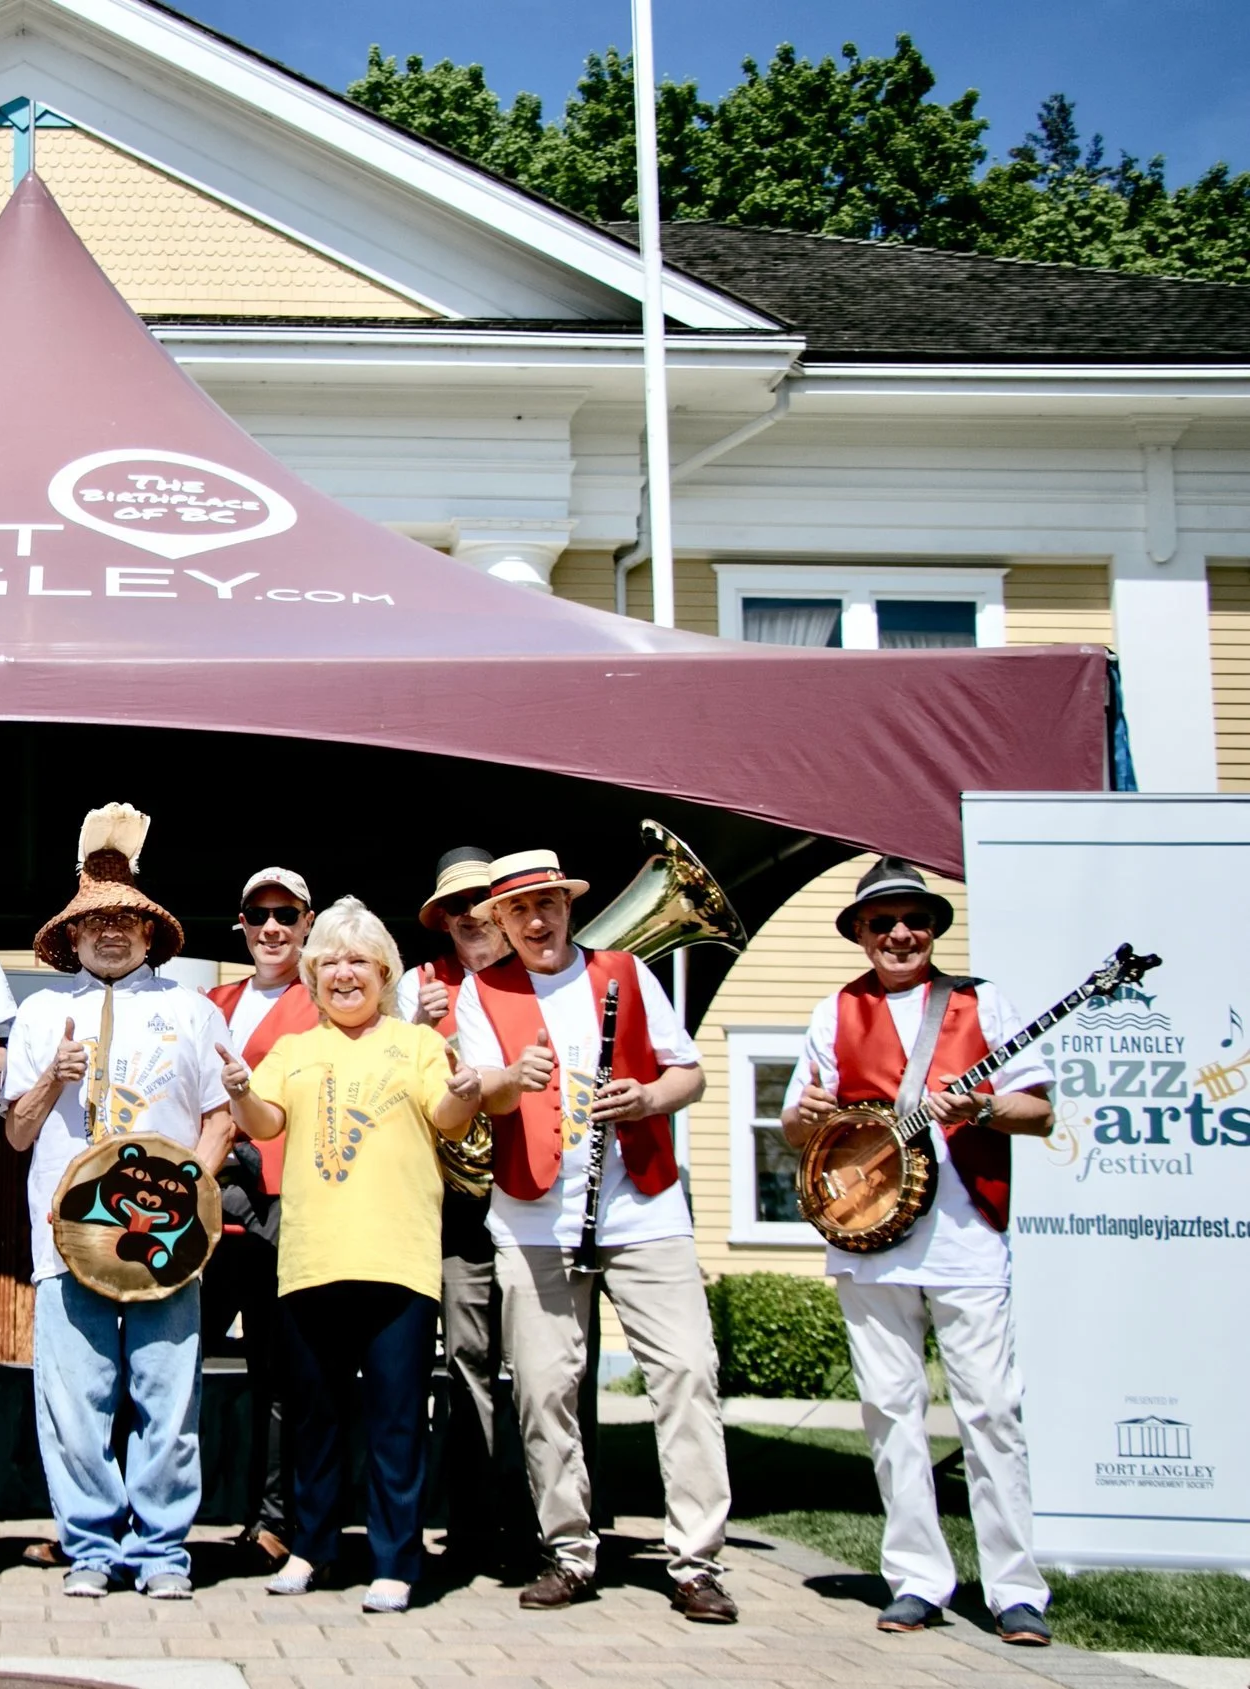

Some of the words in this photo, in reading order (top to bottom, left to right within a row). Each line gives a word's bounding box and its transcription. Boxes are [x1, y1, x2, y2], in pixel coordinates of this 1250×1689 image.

[128, 474, 205, 493] THE
[79, 489, 260, 511] BIRTHPLACE
[114, 507, 168, 520] OF
[175, 507, 237, 524] BC
[1061, 1035, 1103, 1053] FORT
[1110, 1036, 1185, 1054] LANGLEY
[114, 1058, 128, 1083] JAZZ
[143, 1069, 177, 1096] ARTWALK
[347, 1081, 360, 1104] JAZZ
[374, 1088, 410, 1116] ARTWALK
[1094, 1093, 1250, 1147] arts
[1075, 1147, 1194, 1182] festival
[1095, 1463, 1137, 1475] FORT
[1140, 1464, 1216, 1478] LANGLEY
[1095, 1478, 1135, 1487] COMMUNITY
[1186, 1481, 1215, 1490] SOCIETY
